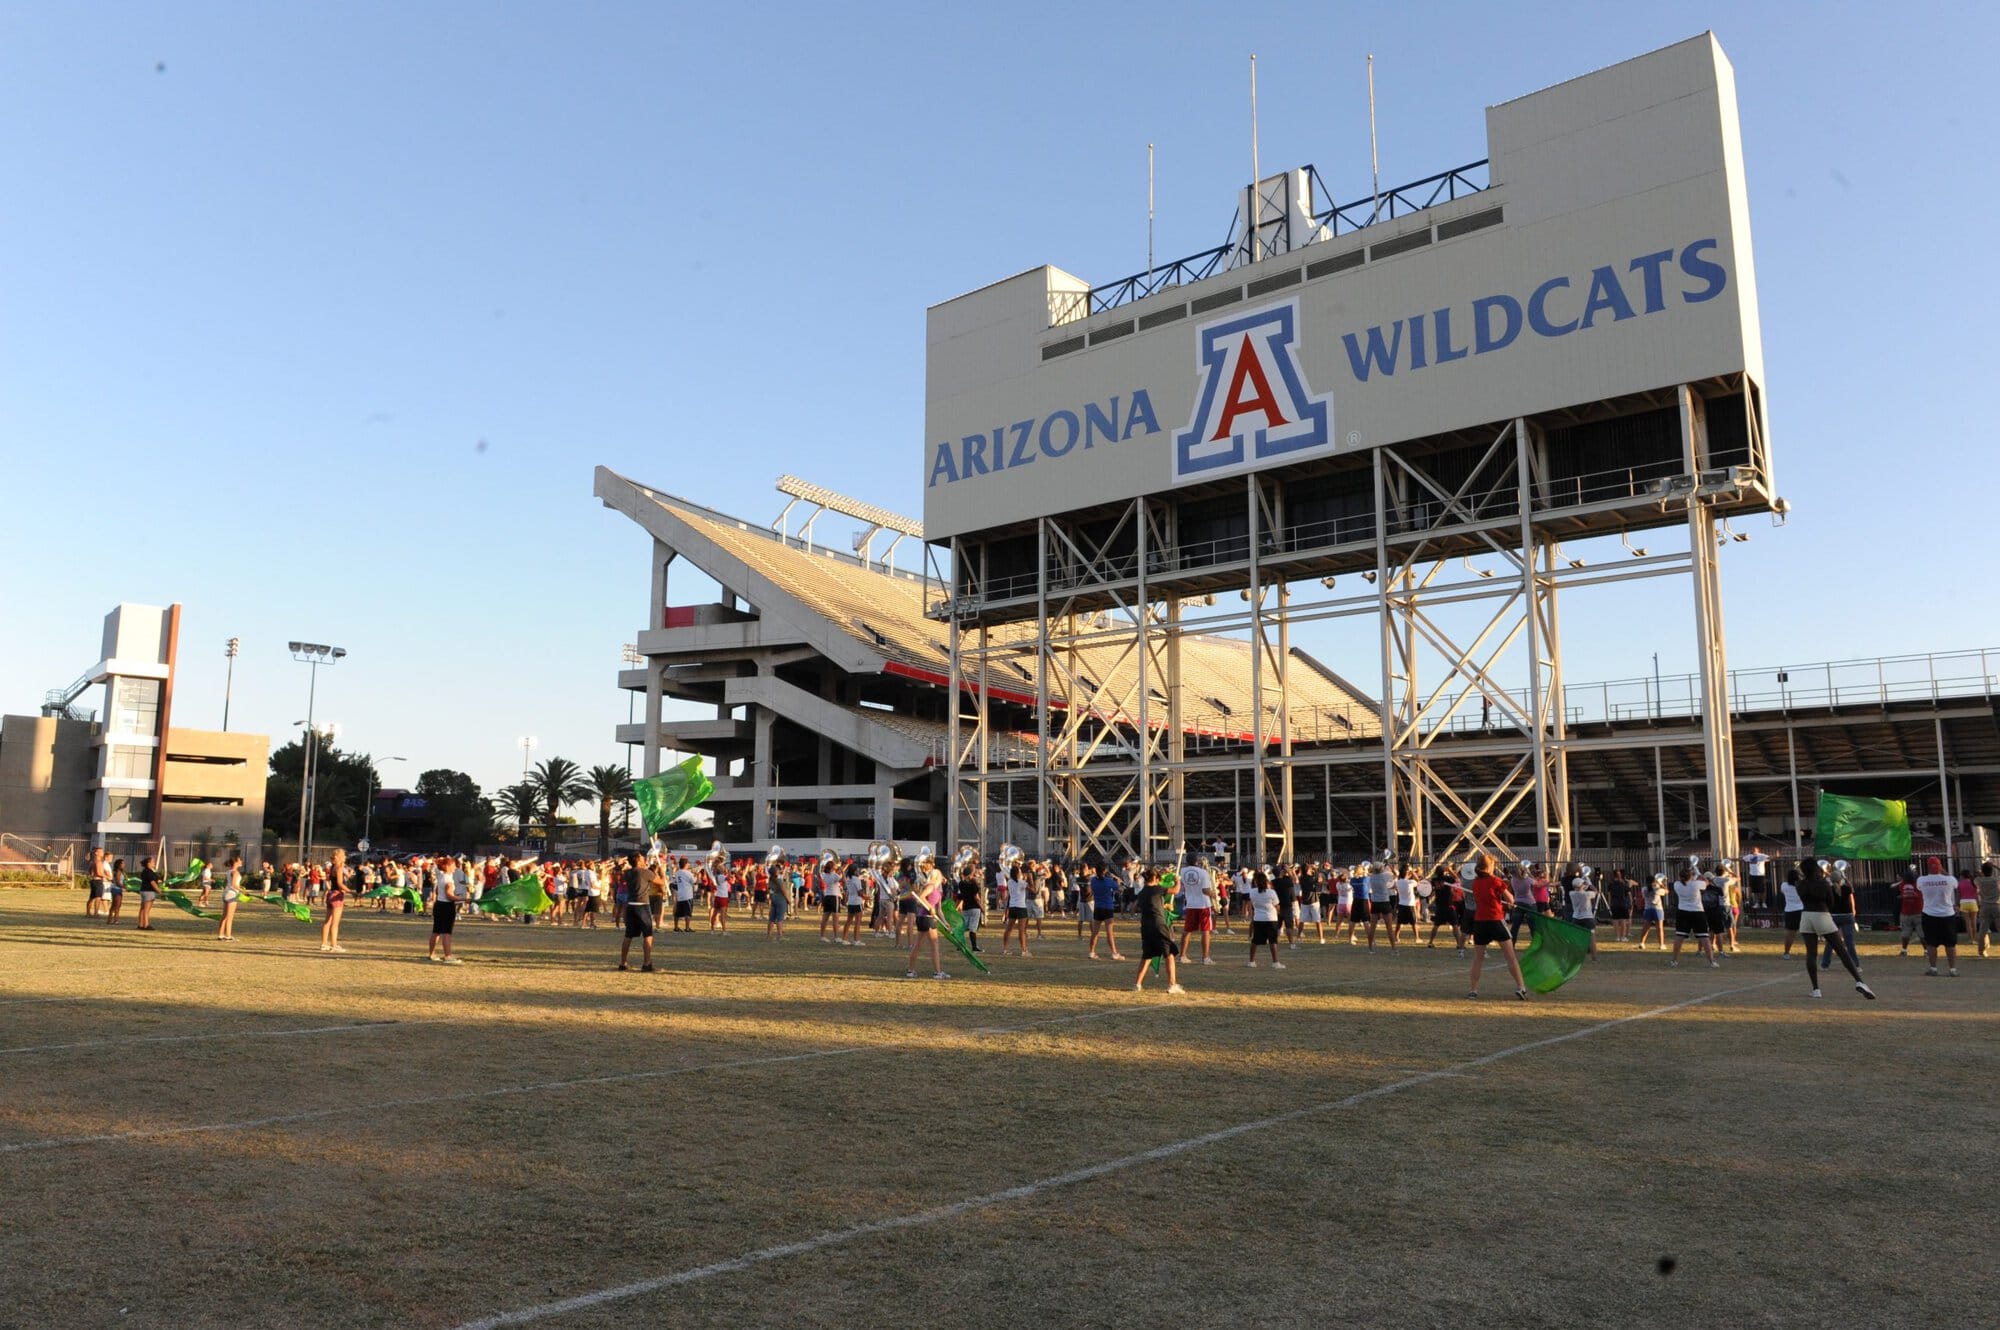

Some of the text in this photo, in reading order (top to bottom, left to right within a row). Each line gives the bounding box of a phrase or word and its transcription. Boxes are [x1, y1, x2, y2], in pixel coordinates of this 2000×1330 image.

[928, 239, 1727, 487] ARIZONA WILDCATS
[1177, 304, 1328, 475] A
